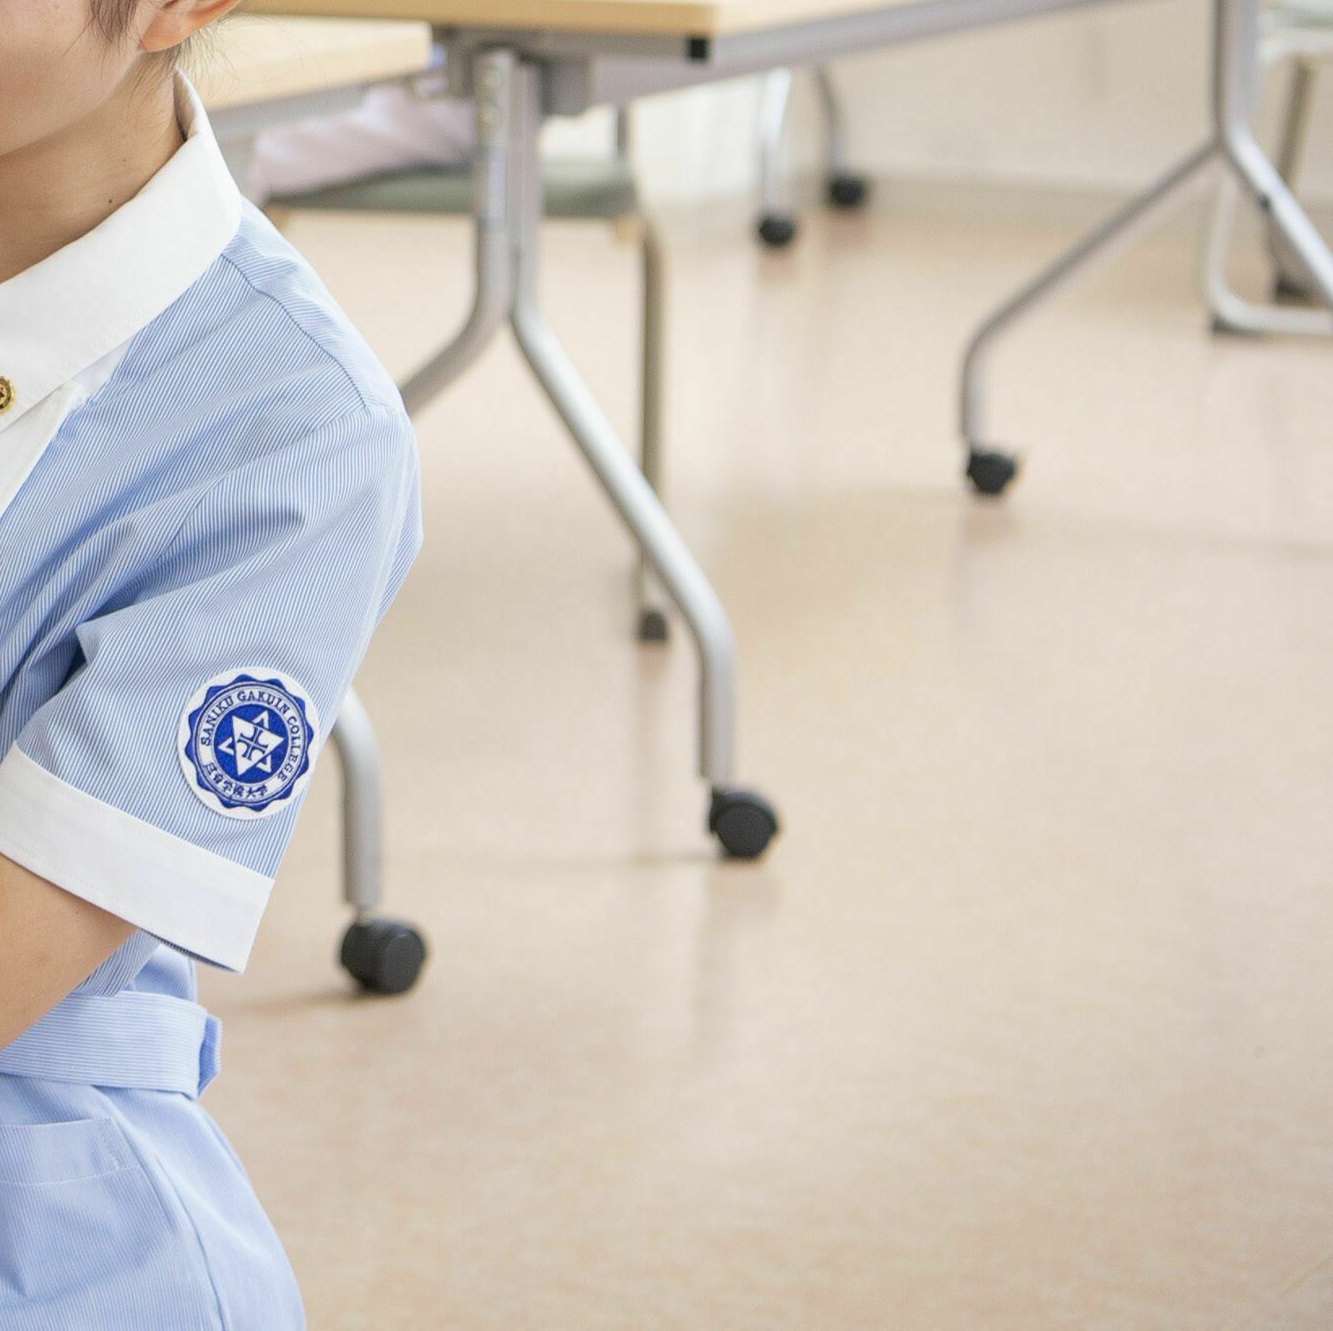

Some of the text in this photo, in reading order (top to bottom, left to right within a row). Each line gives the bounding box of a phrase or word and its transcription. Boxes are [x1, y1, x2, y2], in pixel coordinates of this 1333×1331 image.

[200, 690, 301, 782] SANIKU GAKUIN COLLEGE
